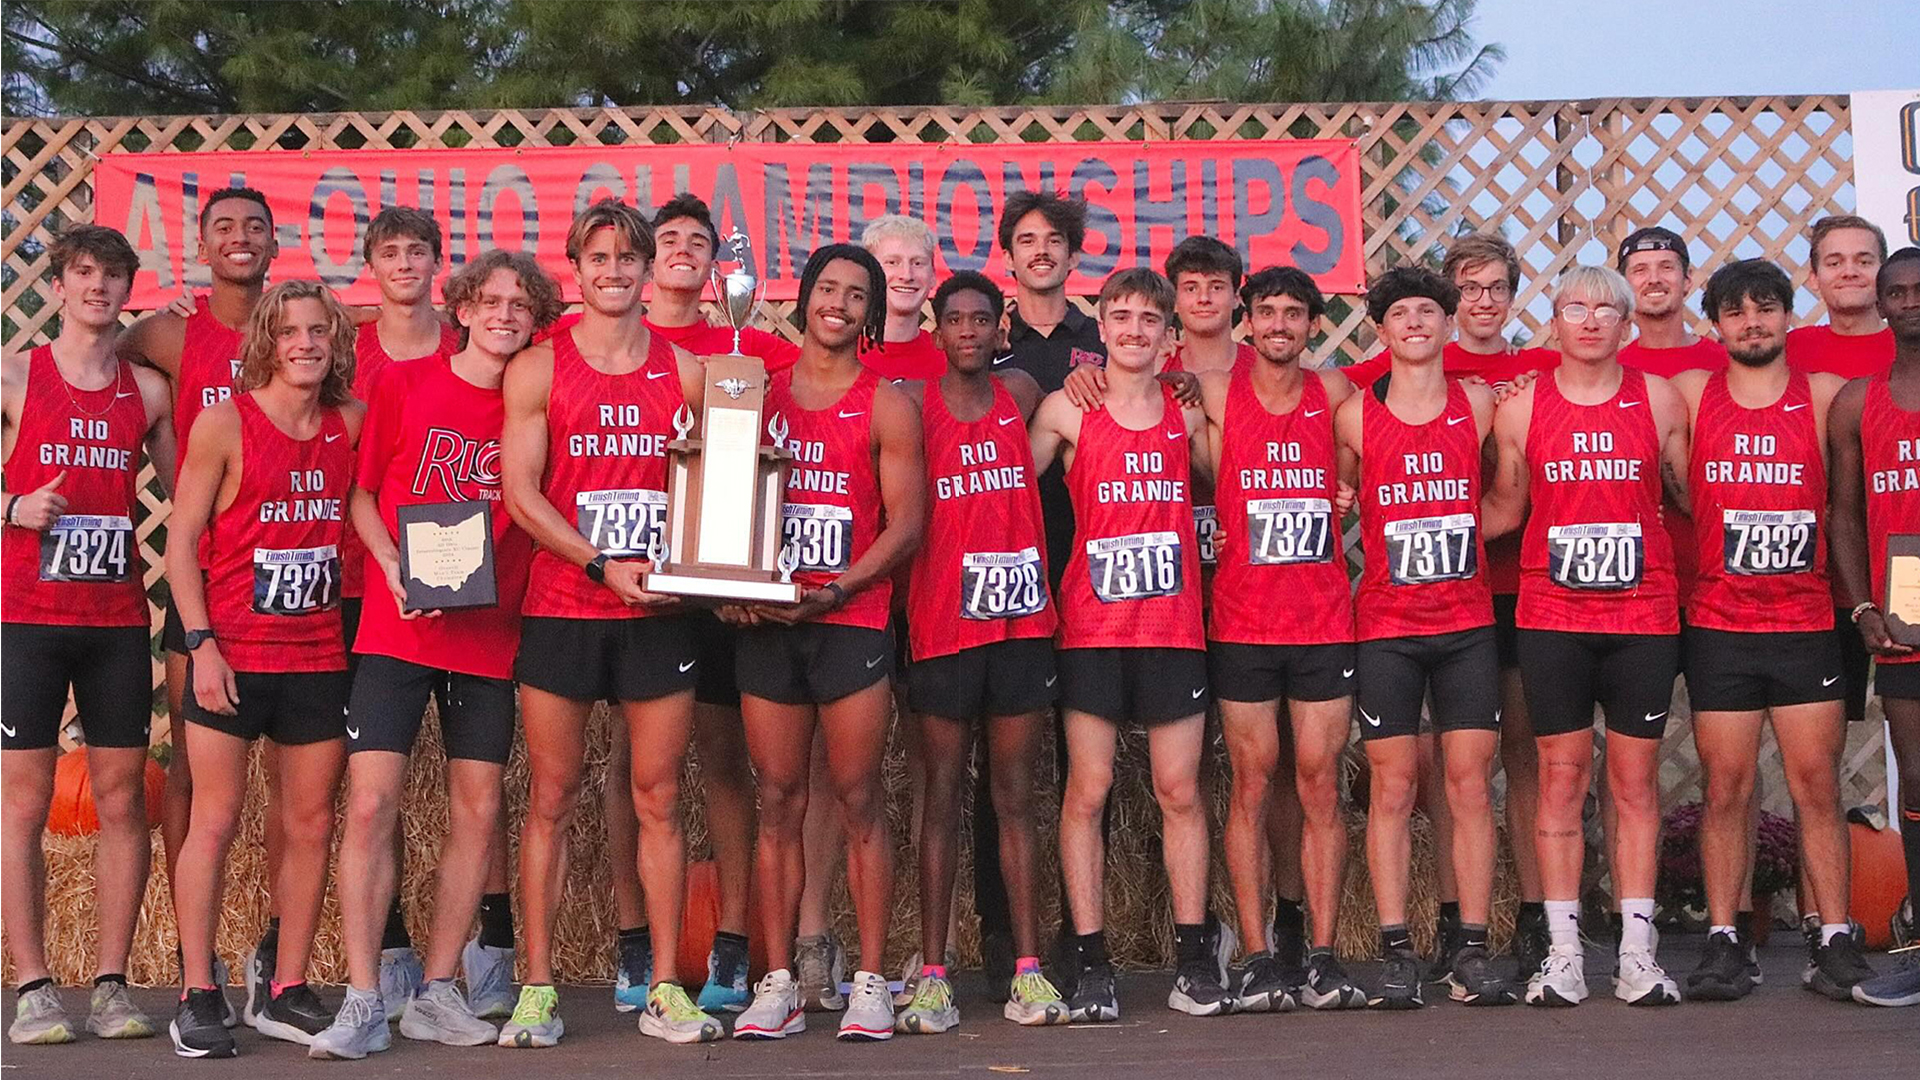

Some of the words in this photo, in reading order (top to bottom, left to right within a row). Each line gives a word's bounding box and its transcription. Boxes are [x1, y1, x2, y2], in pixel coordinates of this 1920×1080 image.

[598, 404, 640, 427] RIO
[70, 417, 108, 440] RIO
[569, 434, 667, 457] GRANDE
[788, 439, 824, 463] RIO
[958, 440, 997, 466] RIO
[1266, 442, 1301, 463] RIO
[1572, 432, 1613, 453] RIO
[1734, 433, 1776, 456] RIO
[1898, 438, 1920, 462] RI
[40, 443, 132, 470] GRANDE
[1124, 452, 1163, 474] RIO
[1403, 452, 1443, 475] RIO
[290, 469, 324, 492] RIO
[788, 468, 850, 495] ANDE
[936, 466, 1026, 500] GRANDE
[1240, 468, 1326, 490] GRANDE
[1544, 459, 1642, 483] GRANDE
[1705, 461, 1804, 485] GRANDE
[1873, 468, 1919, 493] GRA
[588, 491, 640, 502] FinishTiming
[1098, 479, 1184, 504] GRANDE
[1378, 478, 1469, 506] GRANDE
[260, 498, 341, 523] GRANDE
[1258, 500, 1306, 511] FinishTiming
[1734, 511, 1785, 523] FinishTiming
[585, 503, 667, 550] 7325
[1255, 512, 1328, 557] 7327
[1395, 519, 1443, 532] FinishTiming
[1559, 525, 1609, 536] FinishTiming
[50, 529, 126, 575] 7324
[784, 517, 843, 566] 330
[1393, 527, 1470, 578] 7317
[1730, 523, 1809, 568] 7332
[265, 551, 315, 561] FinishTiming
[1556, 537, 1636, 582] 7320
[1095, 545, 1175, 596] 7316
[262, 560, 332, 609] 7321
[968, 562, 1040, 613] 7328
